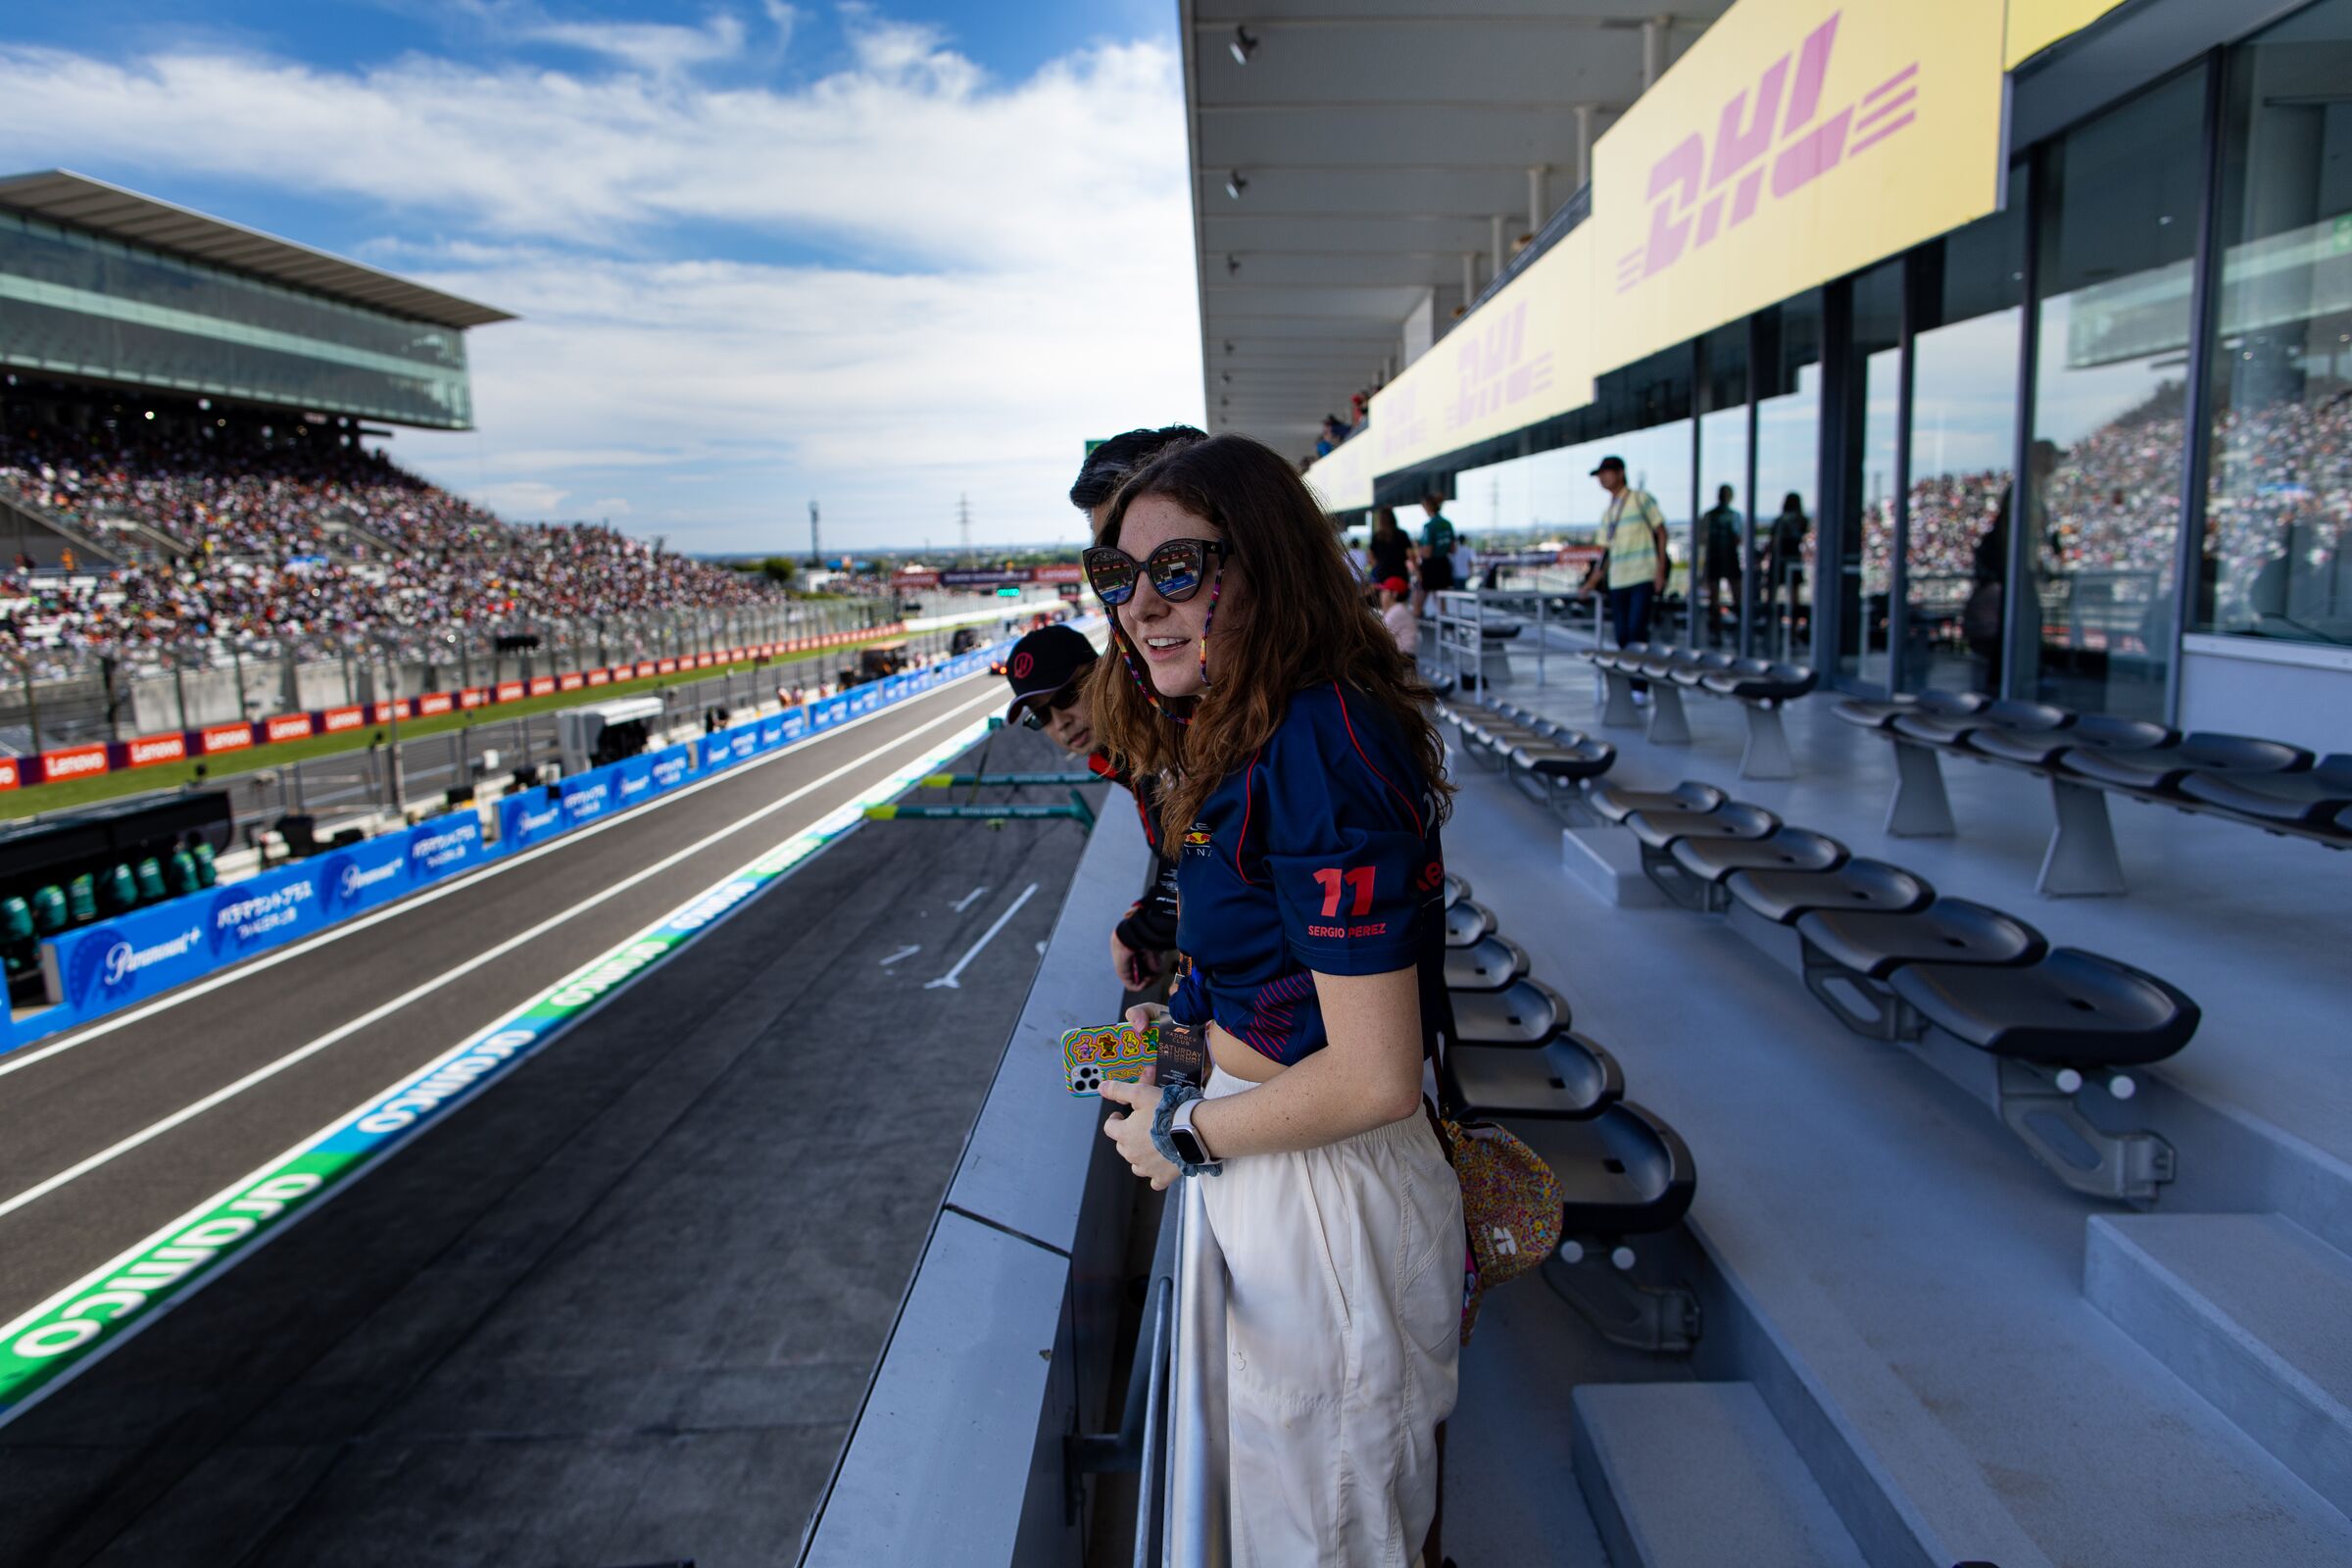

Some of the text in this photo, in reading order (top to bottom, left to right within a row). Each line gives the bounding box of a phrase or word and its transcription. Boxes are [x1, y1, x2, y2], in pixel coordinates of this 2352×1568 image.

[1642, 11, 1854, 278] DHL
[206, 728, 251, 751] Lenovo
[269, 718, 311, 740] Lenovo
[130, 739, 183, 763] Lenovo
[47, 752, 105, 777] Lenovo
[1312, 865, 1376, 917] 11
[1308, 923, 1387, 939] SERGIO PEREZ
[104, 926, 202, 986] Paramount+
[1165, 1031, 1198, 1043] PADDOCK
[1159, 1042, 1201, 1058] SATURDAY
[356, 1030, 537, 1134] aramco
[12, 1173, 324, 1359] aramco
